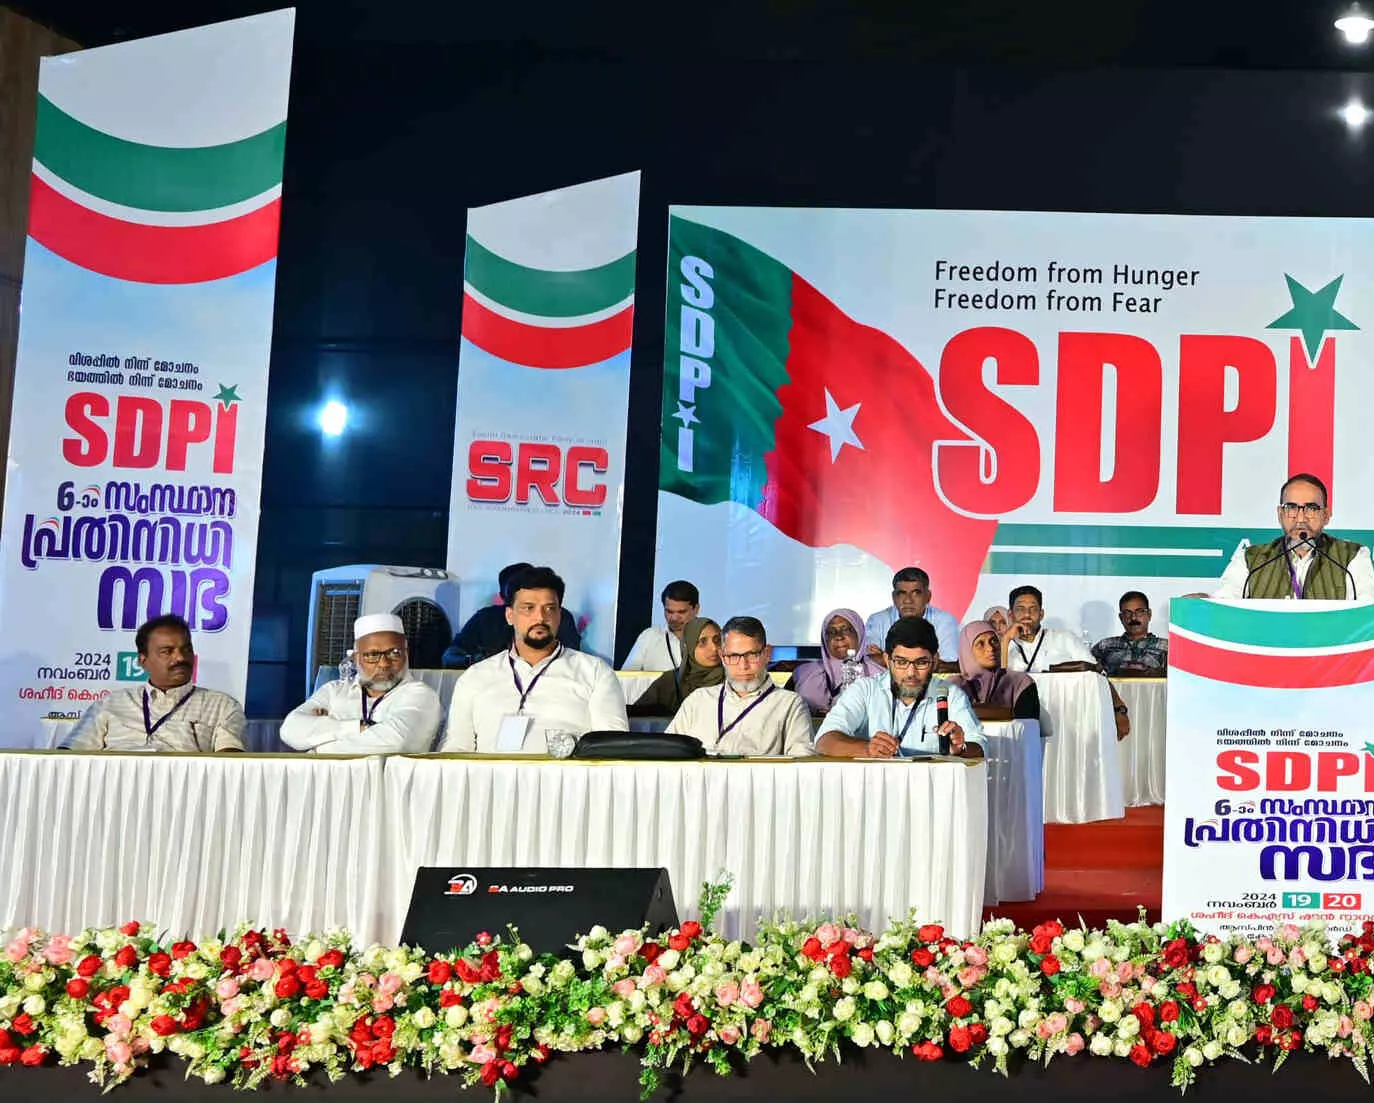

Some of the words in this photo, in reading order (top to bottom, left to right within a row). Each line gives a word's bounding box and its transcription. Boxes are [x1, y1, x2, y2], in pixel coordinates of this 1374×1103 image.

[935, 260, 1037, 282] Freedom
[1047, 261, 1103, 284] from
[1113, 264, 1200, 290] Hunger
[934, 288, 1036, 310] Freedom
[1047, 290, 1102, 312] from
[1112, 292, 1162, 313] Fear
[62, 390, 240, 474] SDPI
[932, 323, 1336, 519] SDPI
[466, 439, 609, 508] SRC
[75, 653, 111, 666] 2024
[37, 667, 110, 680] നവംബർ
[1206, 901, 1277, 909] നവംബർ
[1288, 894, 1312, 907] 19
[1328, 895, 1357, 907] 20
[1242, 893, 1276, 901] 2024
